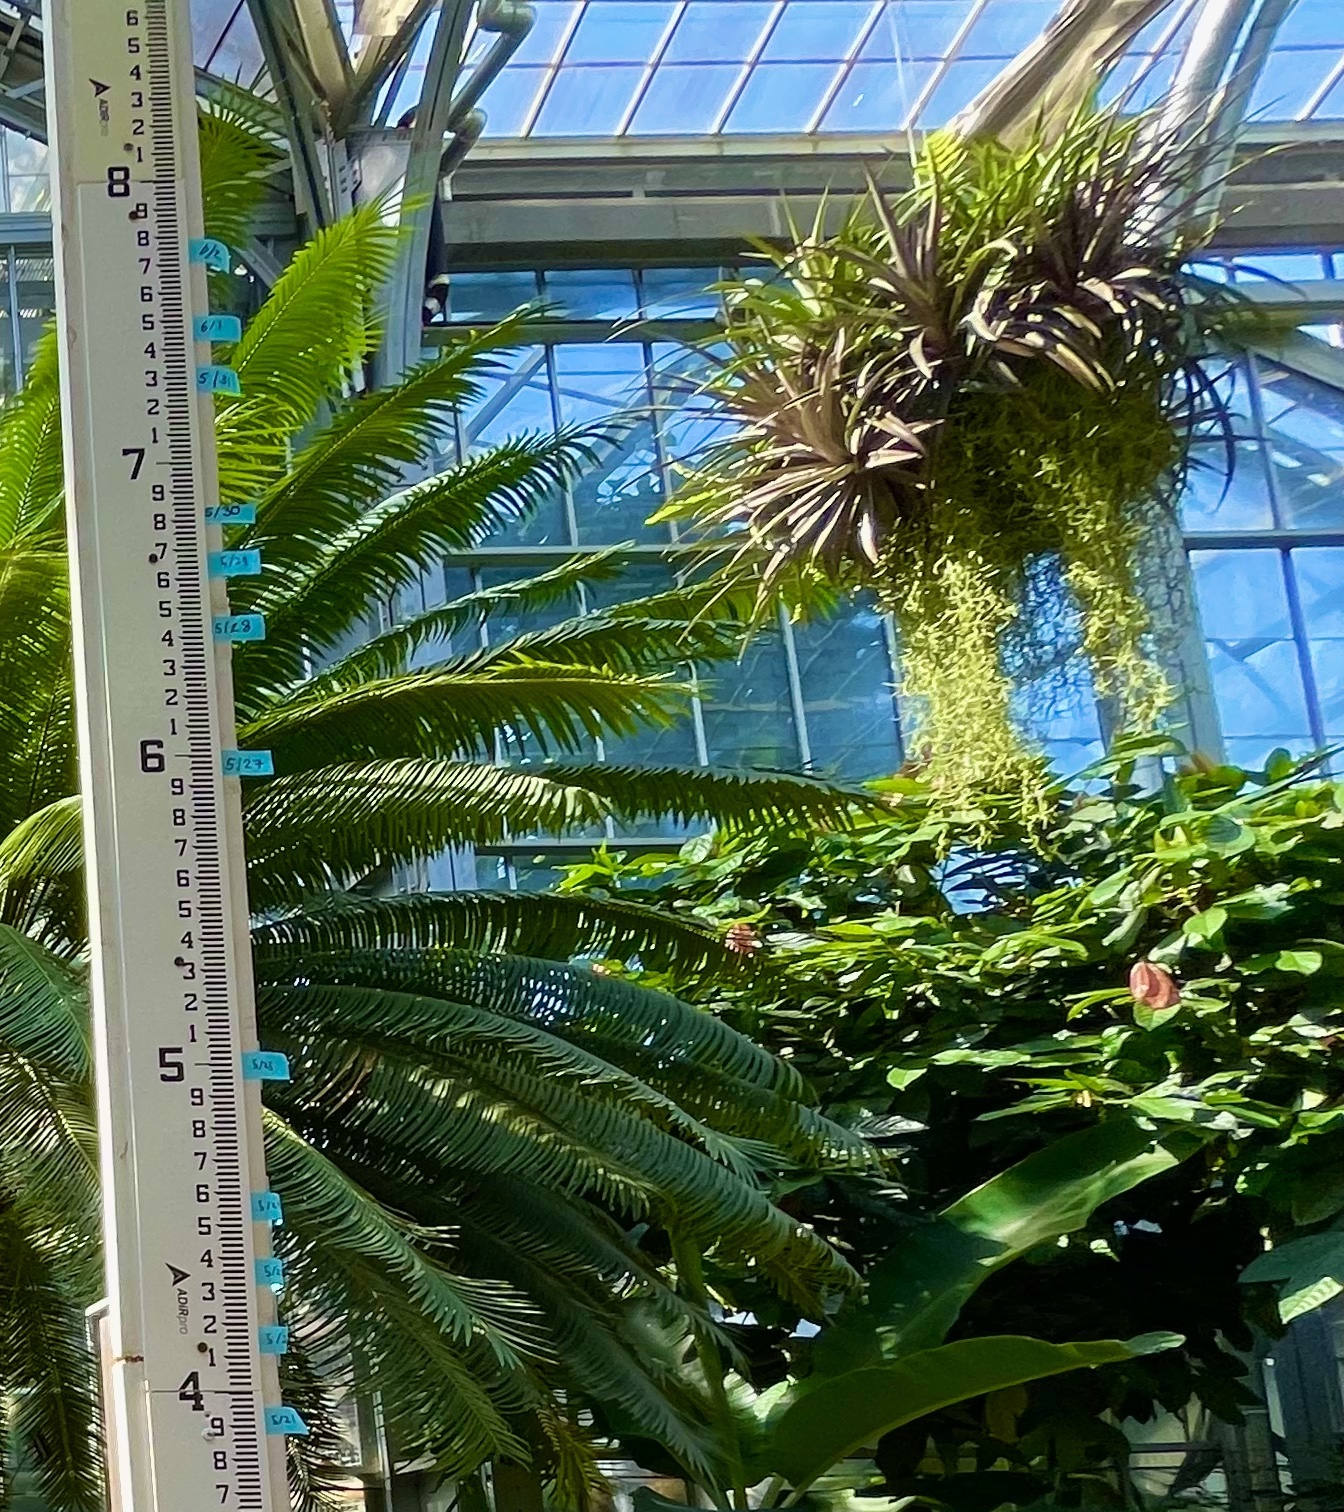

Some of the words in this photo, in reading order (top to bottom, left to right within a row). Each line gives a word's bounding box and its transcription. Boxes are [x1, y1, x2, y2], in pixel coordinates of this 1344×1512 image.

[127, 10, 138, 25] 6
[128, 38, 139, 53] 5
[130, 65, 141, 80] 4
[132, 92, 142, 107] 3
[133, 119, 144, 135] 2
[137, 147, 142, 162] 1
[108, 167, 130, 197] 8
[136, 203, 147, 219] 9
[138, 231, 149, 246] 8
[139, 258, 150, 274] 7
[141, 286, 152, 302] 6
[142, 314, 154, 330] 5
[144, 342, 155, 358] 4
[145, 371, 157, 386] 3
[147, 399, 159, 415] 2
[152, 428, 158, 443] 1
[123, 448, 144, 479] 7
[153, 485, 164, 501] 9
[154, 514, 166, 530] 8
[155, 543, 167, 559] 7
[157, 572, 169, 588] 6
[159, 601, 171, 617] 5
[162, 630, 173, 646] 4
[163, 660, 175, 675] 3
[165, 689, 178, 705] 2
[171, 719, 177, 735] 1
[140, 740, 165, 772] 6
[171, 779, 183, 795] 9
[173, 809, 185, 826] 8
[175, 839, 187, 856] 7
[177, 870, 189, 887] 6
[179, 901, 191, 917] 5
[181, 932, 193, 948] 4
[183, 963, 196, 979] 3
[185, 994, 197, 1011] 2
[190, 1025, 196, 1042] 1
[159, 1047, 184, 1082] 5
[191, 1088, 203, 1106] 9
[193, 1120, 205, 1137] 8
[194, 1152, 206, 1170] 7
[196, 1184, 209, 1202] 6
[198, 1217, 211, 1235] 5
[201, 1250, 213, 1267] 4
[202, 1283, 215, 1300] 3
[204, 1316, 217, 1333] 2
[209, 1348, 216, 1366] 1
[179, 1371, 204, 1411] 4
[212, 1418, 224, 1436] 9
[214, 1451, 227, 1469] 8
[216, 1485, 228, 1503] 7
